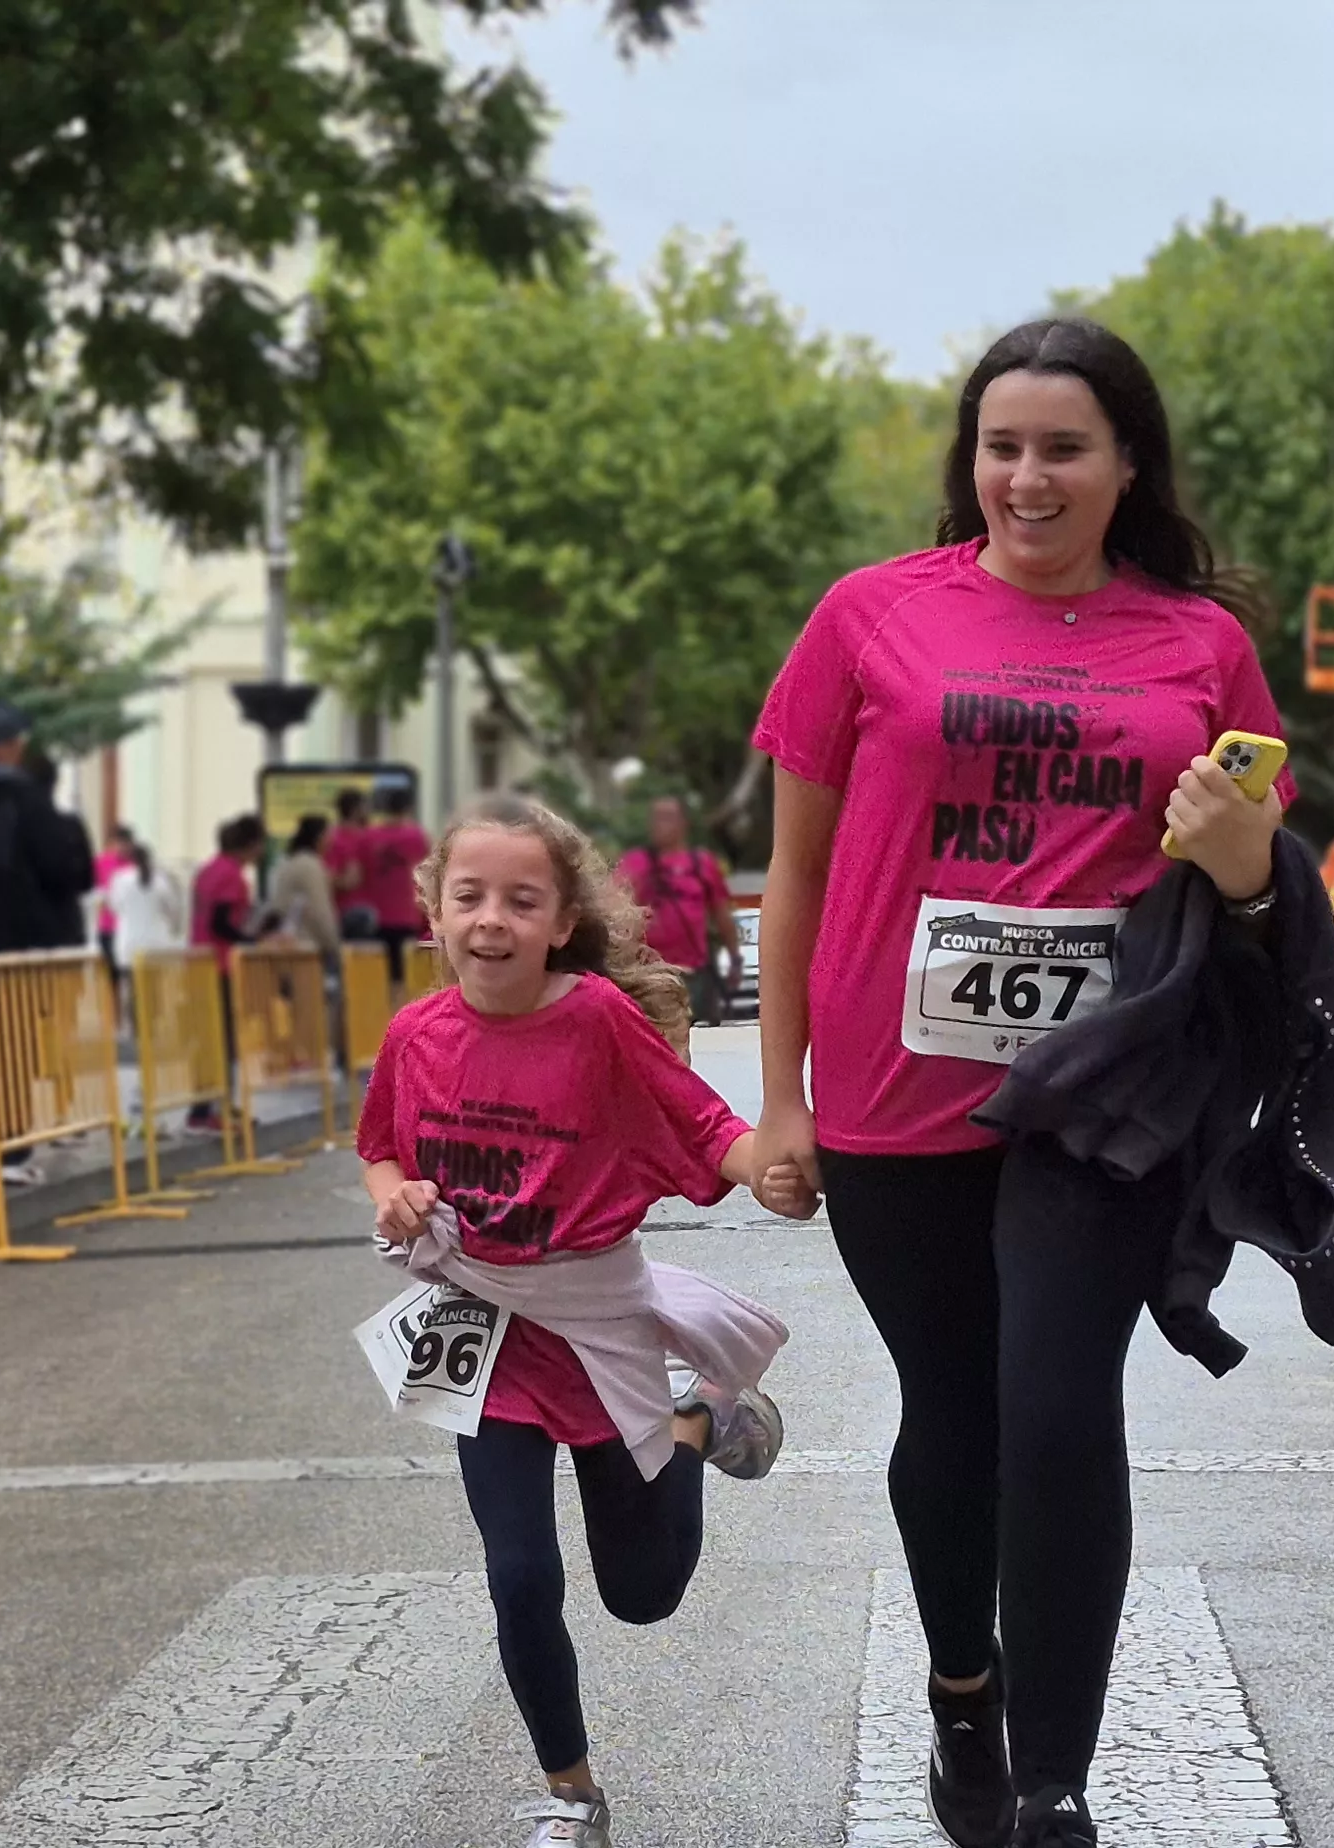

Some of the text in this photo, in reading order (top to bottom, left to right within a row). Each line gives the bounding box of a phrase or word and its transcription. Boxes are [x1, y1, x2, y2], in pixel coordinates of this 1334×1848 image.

[941, 691, 1080, 750] UNIDOS
[993, 750, 1144, 811] EN CADA
[931, 803, 1036, 867] PASO
[940, 933, 1107, 957] CONTRA EL CÁNCER
[1001, 925, 1055, 941] HUESCA
[950, 961, 1090, 1022] 467
